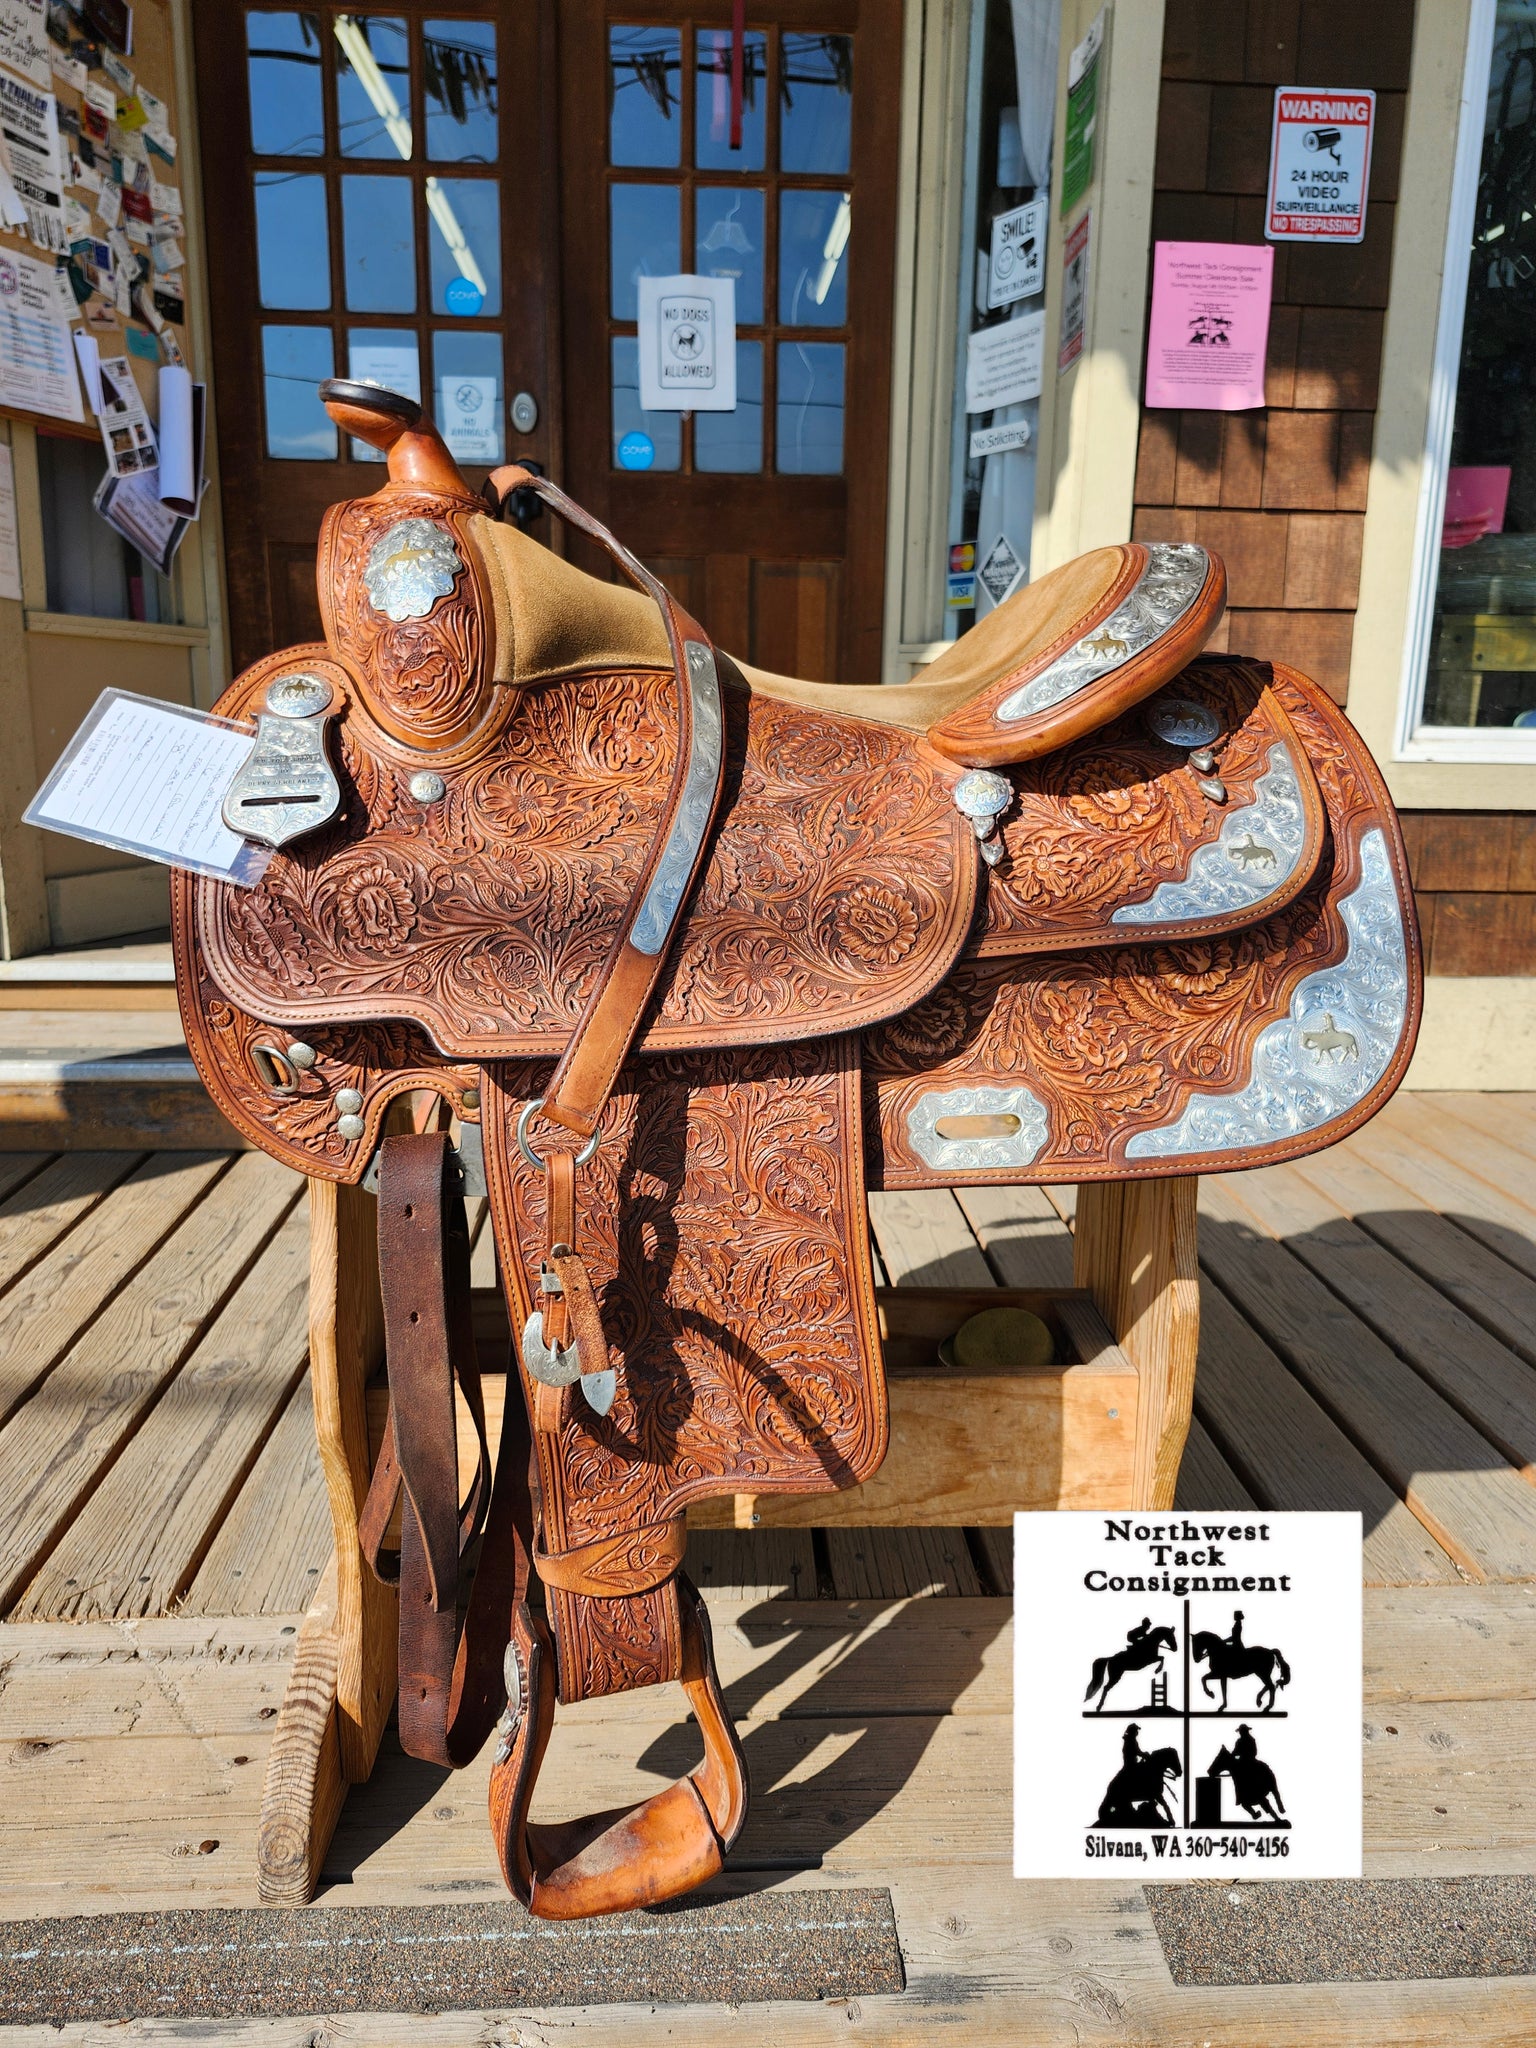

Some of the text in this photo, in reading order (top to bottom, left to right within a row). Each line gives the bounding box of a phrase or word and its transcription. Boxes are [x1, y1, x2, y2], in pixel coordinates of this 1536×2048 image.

[1280, 99, 1369, 121] WARNING
[1291, 169, 1349, 183] 24 HOUR
[1298, 186, 1340, 199] VIDEO
[1276, 201, 1360, 214] SURVEILLANCE
[1272, 216, 1359, 233] NO TRESPASSING
[664, 309, 710, 321] NO DOGS
[664, 364, 712, 378] ALLOWED
